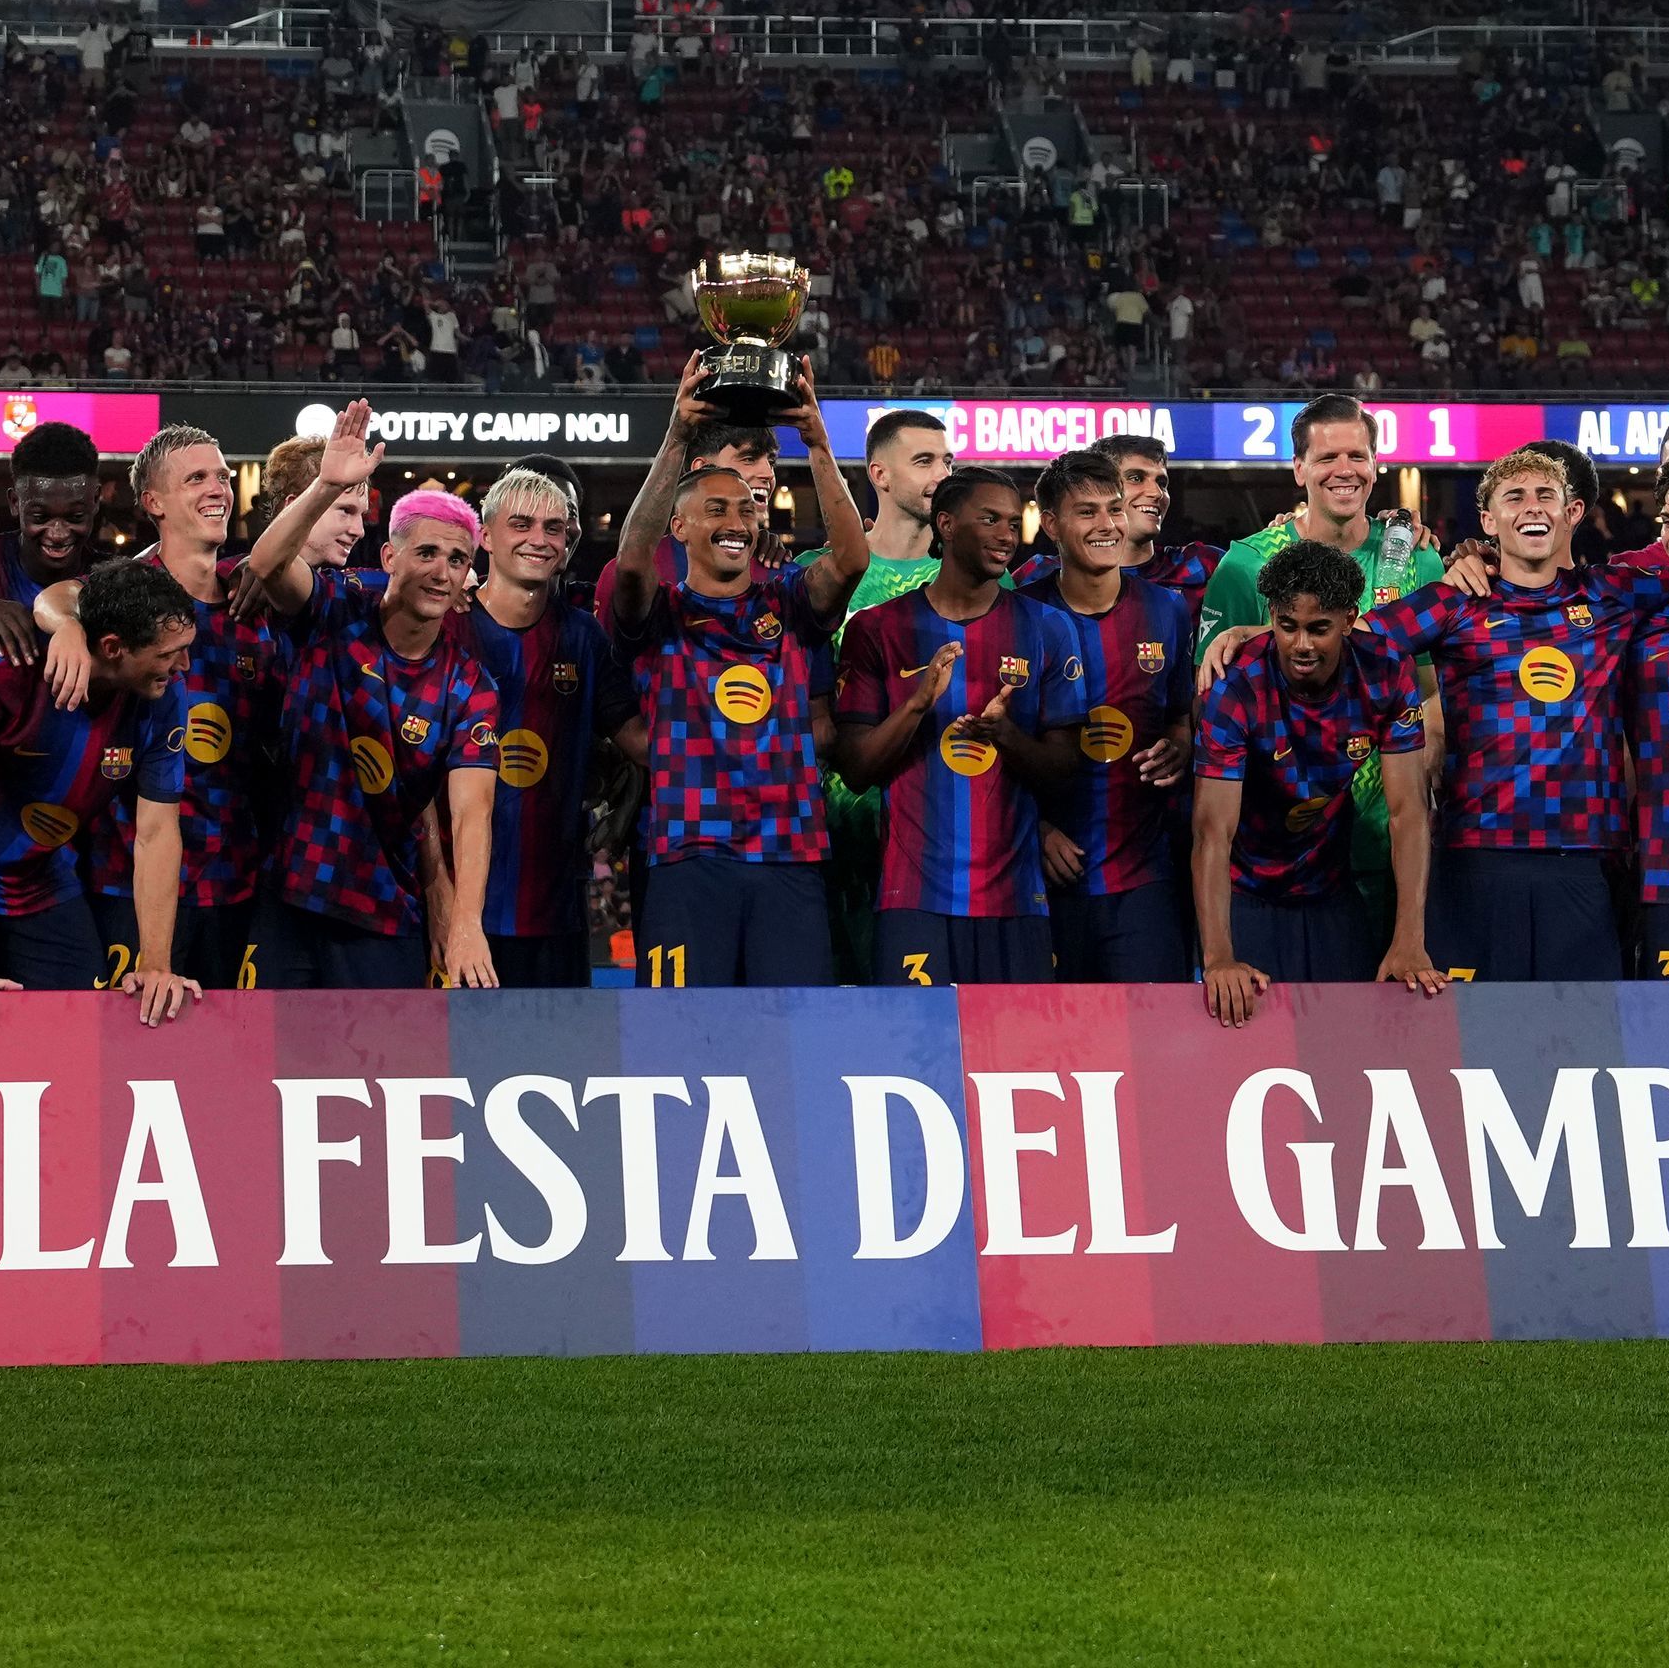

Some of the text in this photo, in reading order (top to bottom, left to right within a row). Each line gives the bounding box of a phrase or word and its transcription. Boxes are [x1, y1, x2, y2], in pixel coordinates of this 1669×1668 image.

[364, 411, 630, 442] POTIFY CAMP NOU
[1244, 407, 1275, 455] 2
[1430, 409, 1455, 456] 1
[1578, 410, 1620, 457] AL
[648, 945, 684, 987] 11
[273, 1075, 798, 1265] FESTA
[842, 1070, 1179, 1261] DEL
